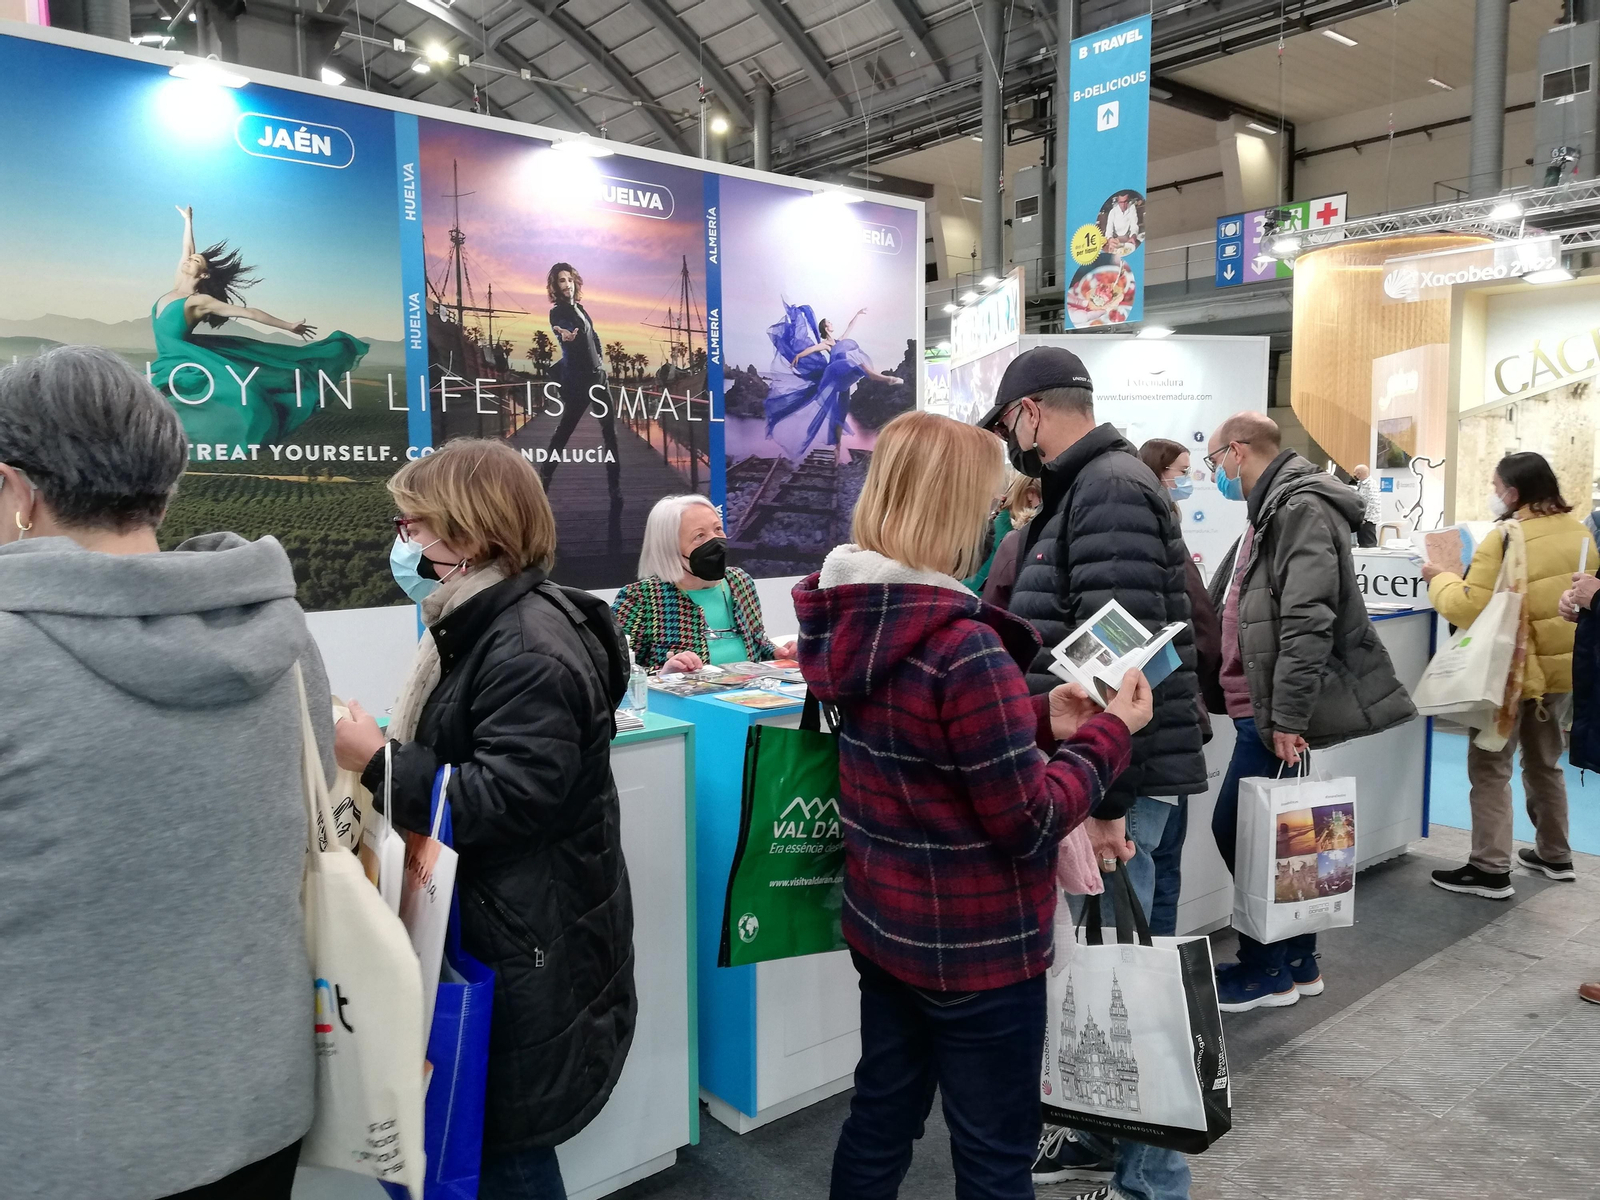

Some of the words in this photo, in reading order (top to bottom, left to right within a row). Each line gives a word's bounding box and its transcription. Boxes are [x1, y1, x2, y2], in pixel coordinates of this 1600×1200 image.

[1079, 46, 1088, 60] B
[1093, 28, 1143, 54] TRAVEL
[1073, 70, 1147, 102] B-DELICIOUS
[257, 125, 331, 156] JAÉN
[402, 162, 416, 221] HUELVA
[602, 183, 664, 211] UELVA
[706, 206, 718, 265] ALMERÍA
[862, 227, 896, 248] ERÍA
[1084, 232, 1097, 247] 1€
[1420, 264, 1508, 289] Xacobeo
[408, 292, 422, 350] HUELVA
[708, 308, 720, 365] ALMERÍA
[1494, 327, 1600, 397] CÁC
[294, 368, 353, 410] IN
[387, 372, 498, 415] LIFE
[526, 380, 566, 418] IS
[589, 383, 725, 422] SMALL
[1096, 392, 1213, 401] www.turismoextremadura.com
[1127, 378, 1184, 387] Extremadura
[187, 443, 261, 461] TREAT
[269, 444, 398, 462] YOURSELF.
[520, 445, 616, 463] NDALUCÍA
[1356, 563, 1429, 598] ácer
[773, 820, 808, 838] VAL
[811, 817, 845, 838] D'A
[769, 842, 784, 854] Era
[1081, 1116, 1112, 1127] SANTIAGO
[1122, 1124, 1165, 1136] COMPOSTELA
